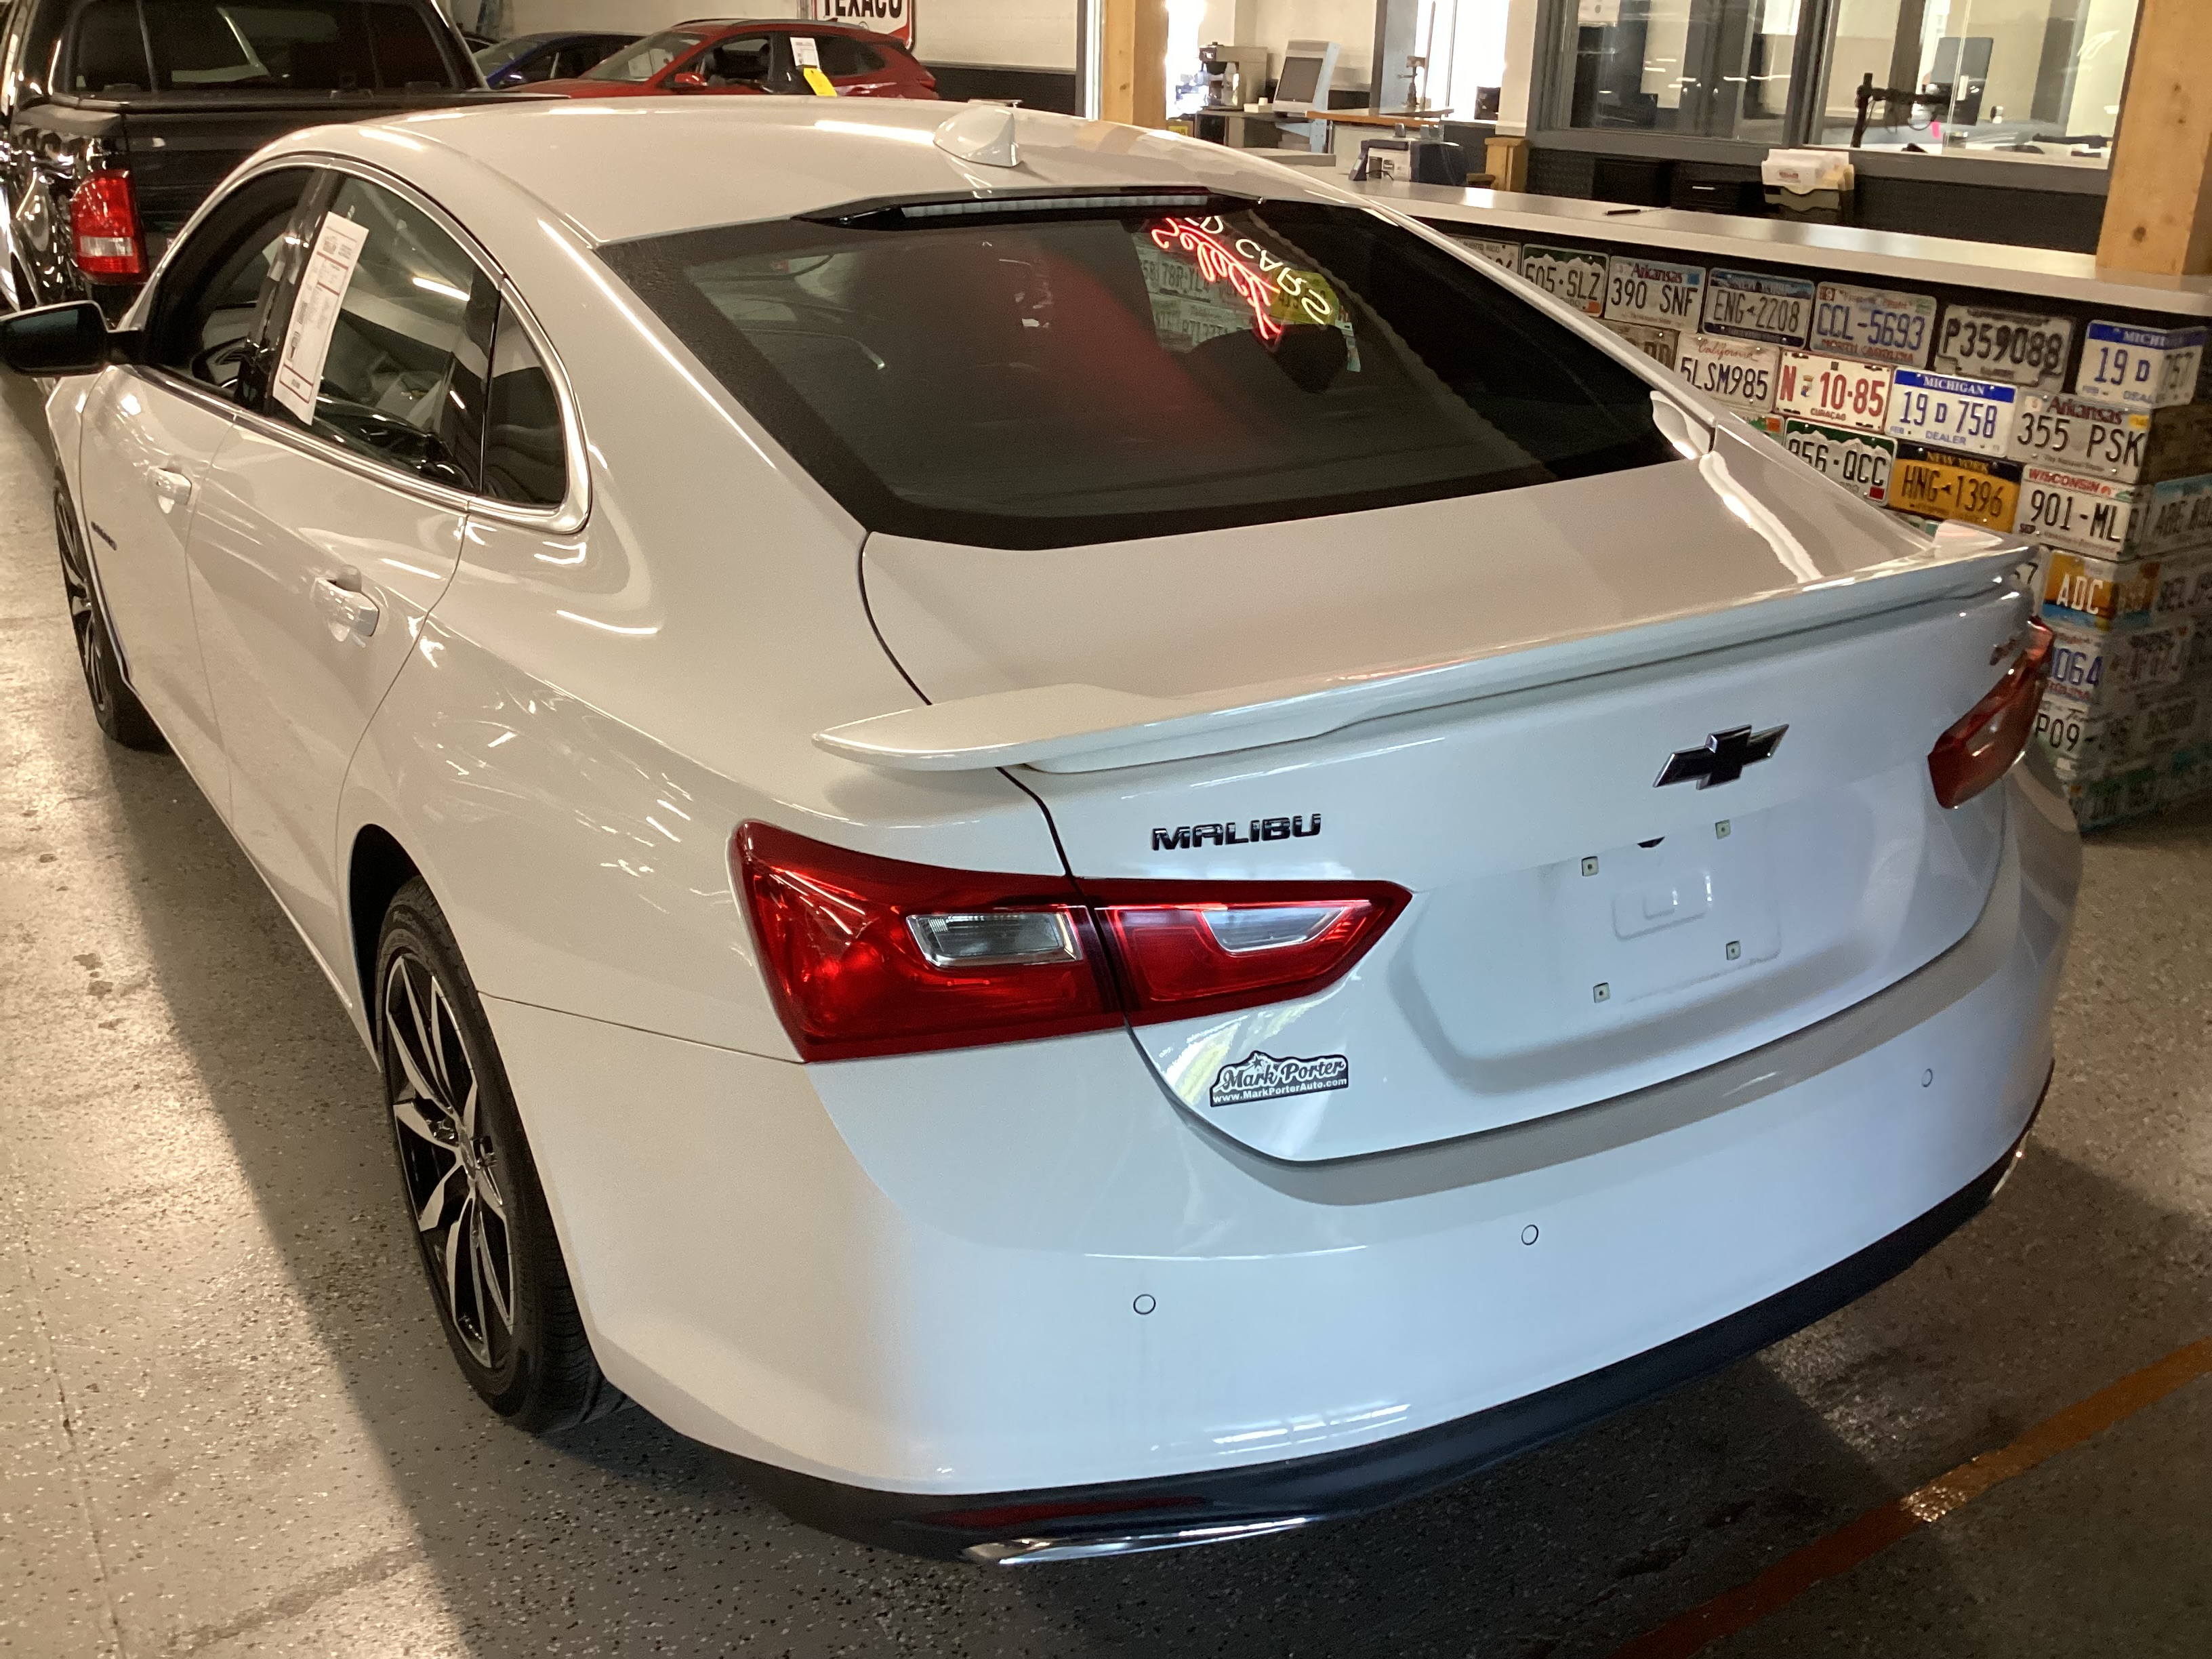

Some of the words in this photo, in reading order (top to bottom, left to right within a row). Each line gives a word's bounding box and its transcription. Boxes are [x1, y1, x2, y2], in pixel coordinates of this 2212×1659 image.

[1631, 262, 1683, 284] Arkansas
[1611, 276, 1648, 310] 390
[1660, 284, 1698, 317] SNF
[1698, 340, 1759, 362] California
[2093, 346, 2129, 386] 19
[2135, 359, 2151, 382] D
[1680, 356, 1769, 401] 5LSM985
[1780, 365, 1797, 402] N
[1923, 376, 1985, 396] MICHIGAN
[1900, 390, 1929, 427] 19
[1935, 403, 1948, 424] D
[1956, 399, 1998, 439] 758
[2047, 396, 2123, 426] Arkansas
[1925, 430, 1967, 445] DEALER
[2017, 411, 2070, 453] 355
[2086, 424, 2146, 467] PSK
[2028, 468, 2101, 493] WISCONSIN
[1151, 813, 1322, 851] MALIBU
[1220, 1063, 1278, 1090] Mark
[1279, 1059, 1345, 1082] Porter
[1212, 1078, 1347, 1103] www.MarkPorterAuto.com
